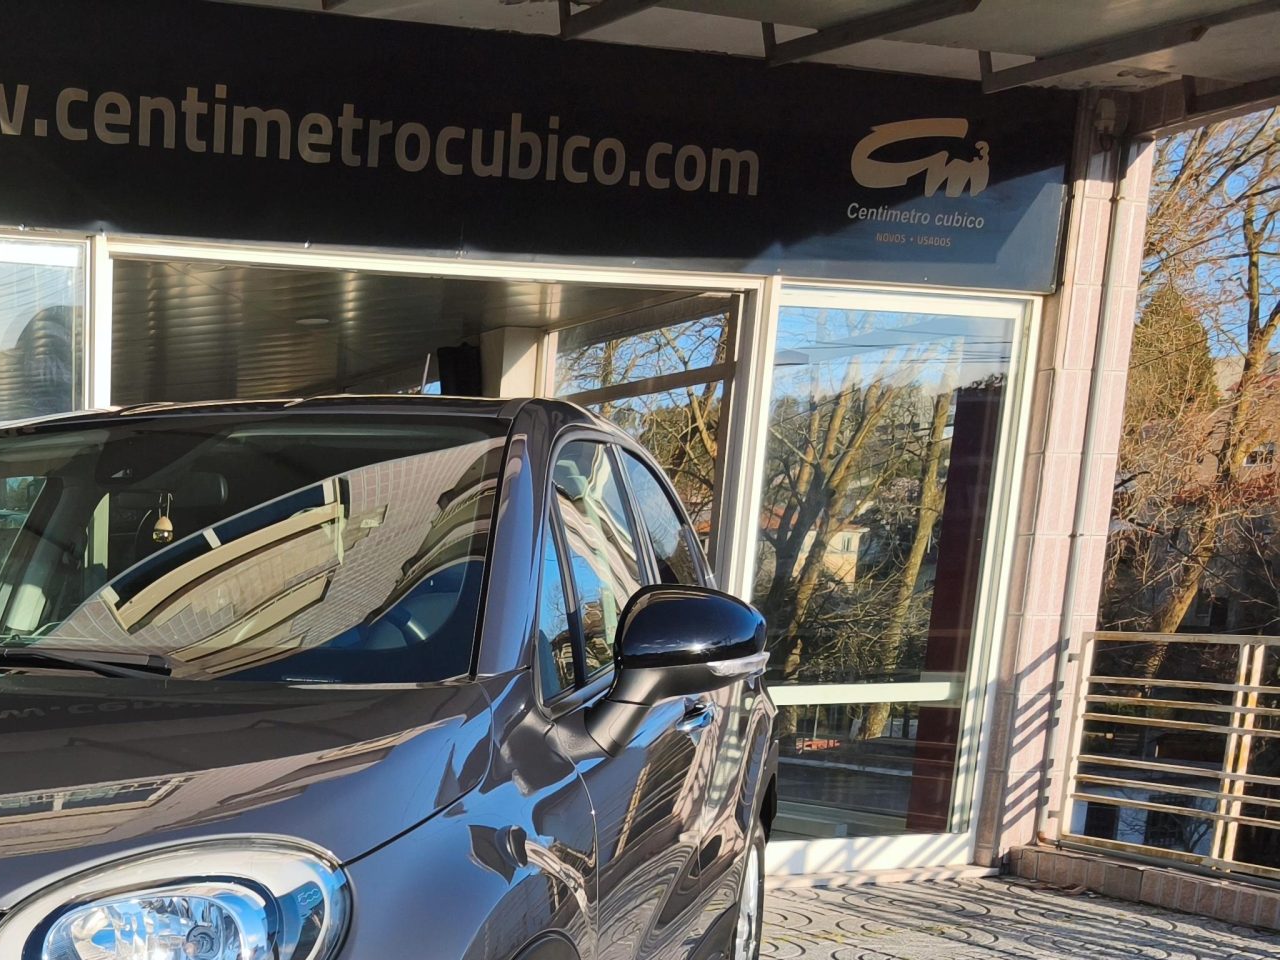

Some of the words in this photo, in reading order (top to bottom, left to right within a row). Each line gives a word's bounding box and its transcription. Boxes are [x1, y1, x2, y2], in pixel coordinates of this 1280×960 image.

[847, 202, 931, 225] Centimetro
[934, 211, 985, 229] cubico
[876, 232, 906, 243] NOVOS
[917, 235, 951, 247] USADOS
